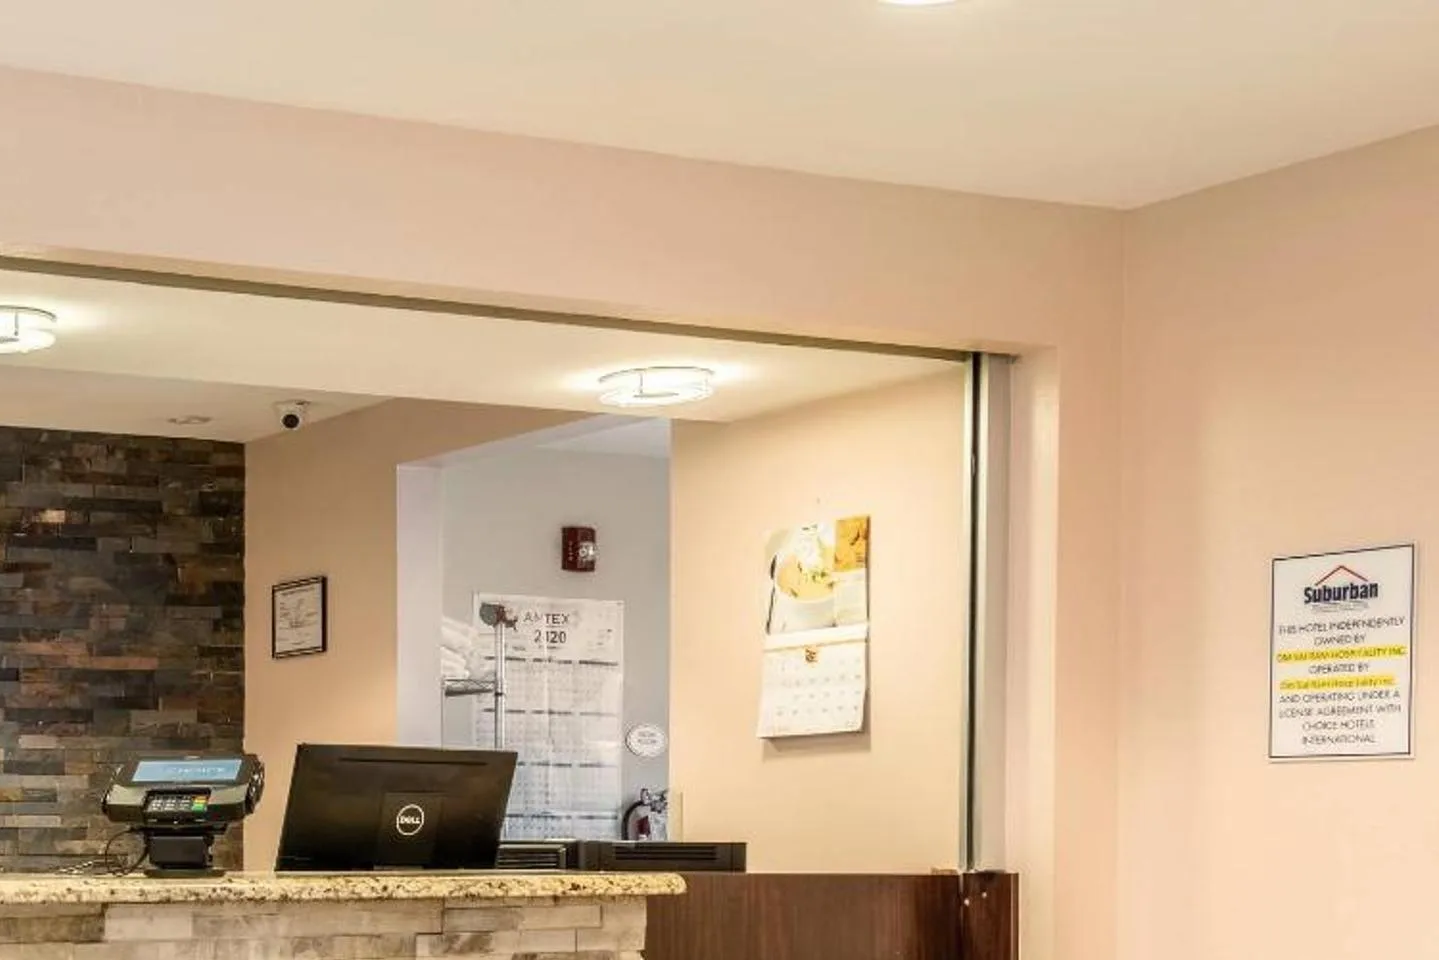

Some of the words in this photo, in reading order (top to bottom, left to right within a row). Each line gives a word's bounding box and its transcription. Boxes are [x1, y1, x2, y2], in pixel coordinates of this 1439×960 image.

[1304, 582, 1379, 604] Suburban
[1314, 635, 1351, 646] OWNED
[1308, 664, 1355, 674] OPERATED
[400, 815, 421, 824] DELL
